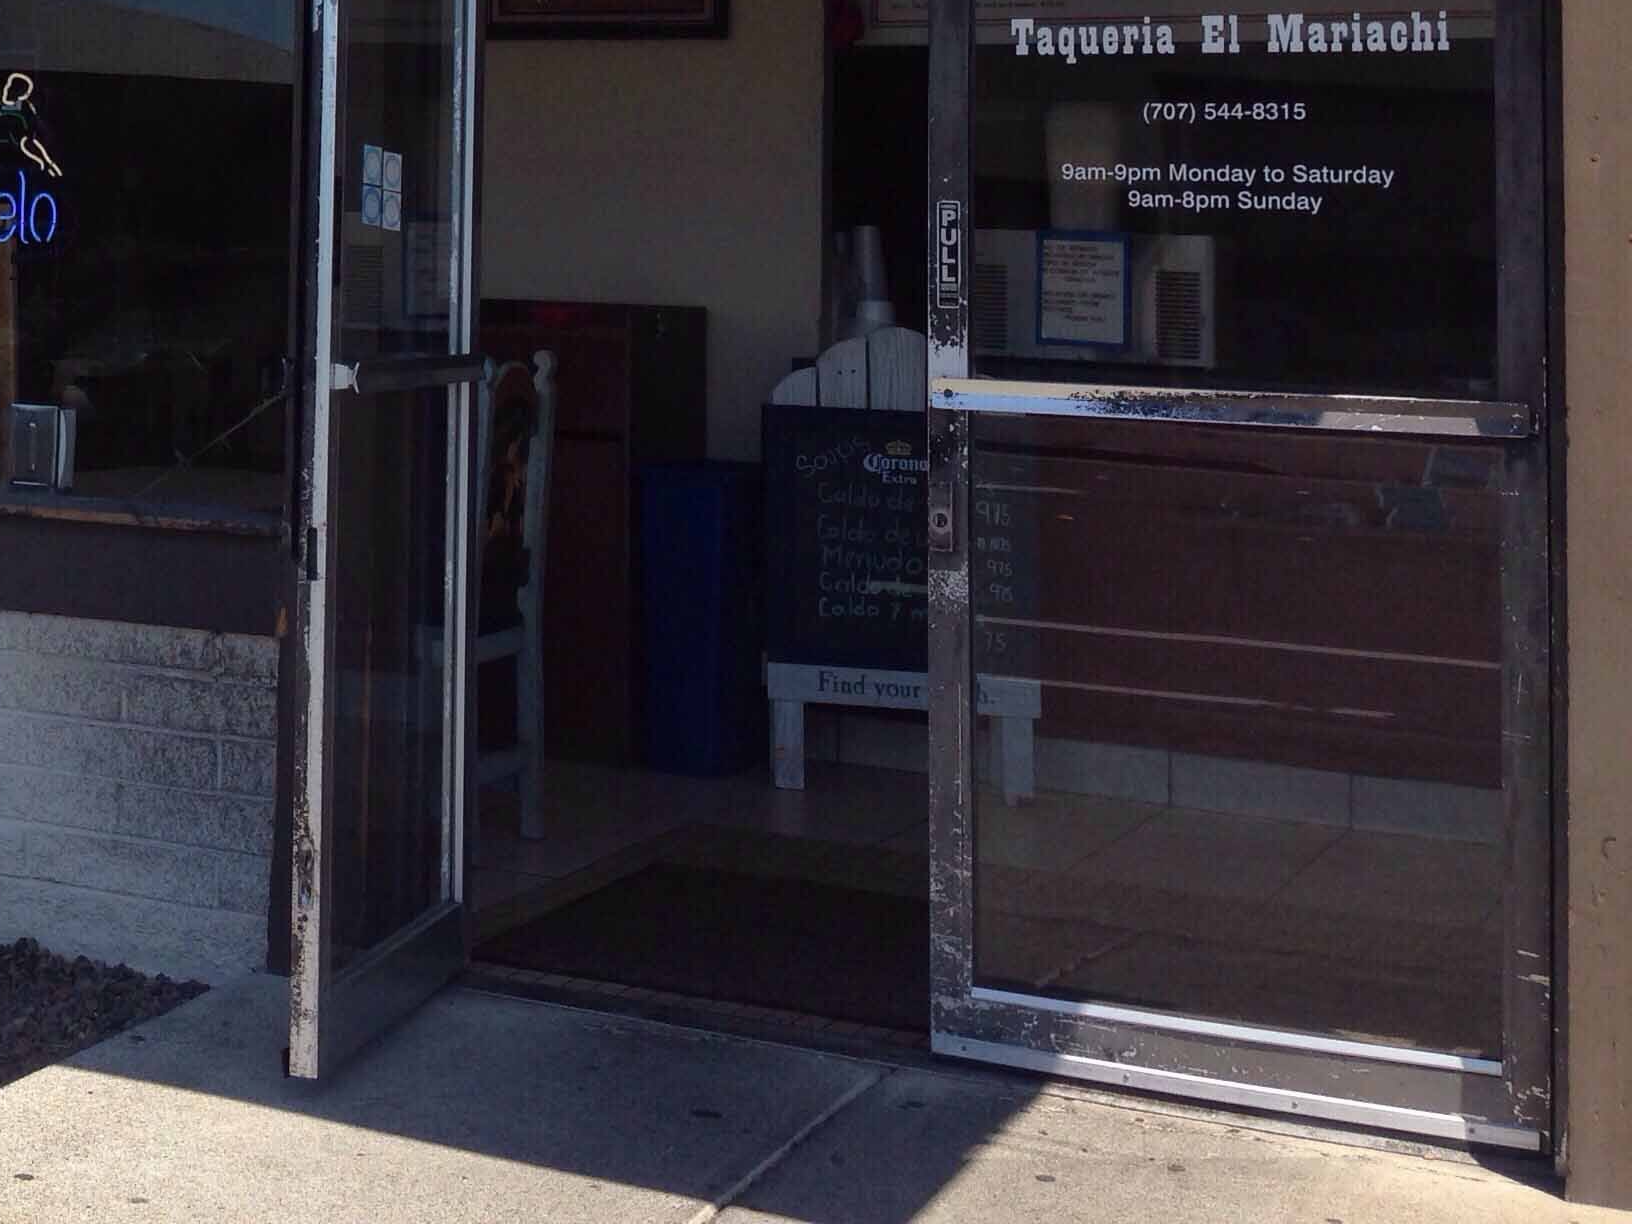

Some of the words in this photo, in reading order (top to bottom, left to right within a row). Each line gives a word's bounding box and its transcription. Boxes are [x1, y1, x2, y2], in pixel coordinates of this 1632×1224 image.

[1010, 16, 1176, 65] Taqueria
[1200, 14, 1241, 54] El
[1267, 10, 1450, 53] Mariachi
[1143, 102, 1197, 124] (707)
[1203, 102, 1307, 121] 544-8315
[1061, 163, 1161, 185] 9am-9pm
[1168, 163, 1257, 187] Monday
[1262, 165, 1285, 183] to
[1292, 164, 1395, 189] Saturday
[1127, 190, 1230, 213] 9am-8pm
[1237, 191, 1323, 215] Sunday
[940, 209, 957, 283] PULL
[880, 471, 918, 486] Extra
[817, 671, 867, 697] Find
[873, 682, 921, 705] your
